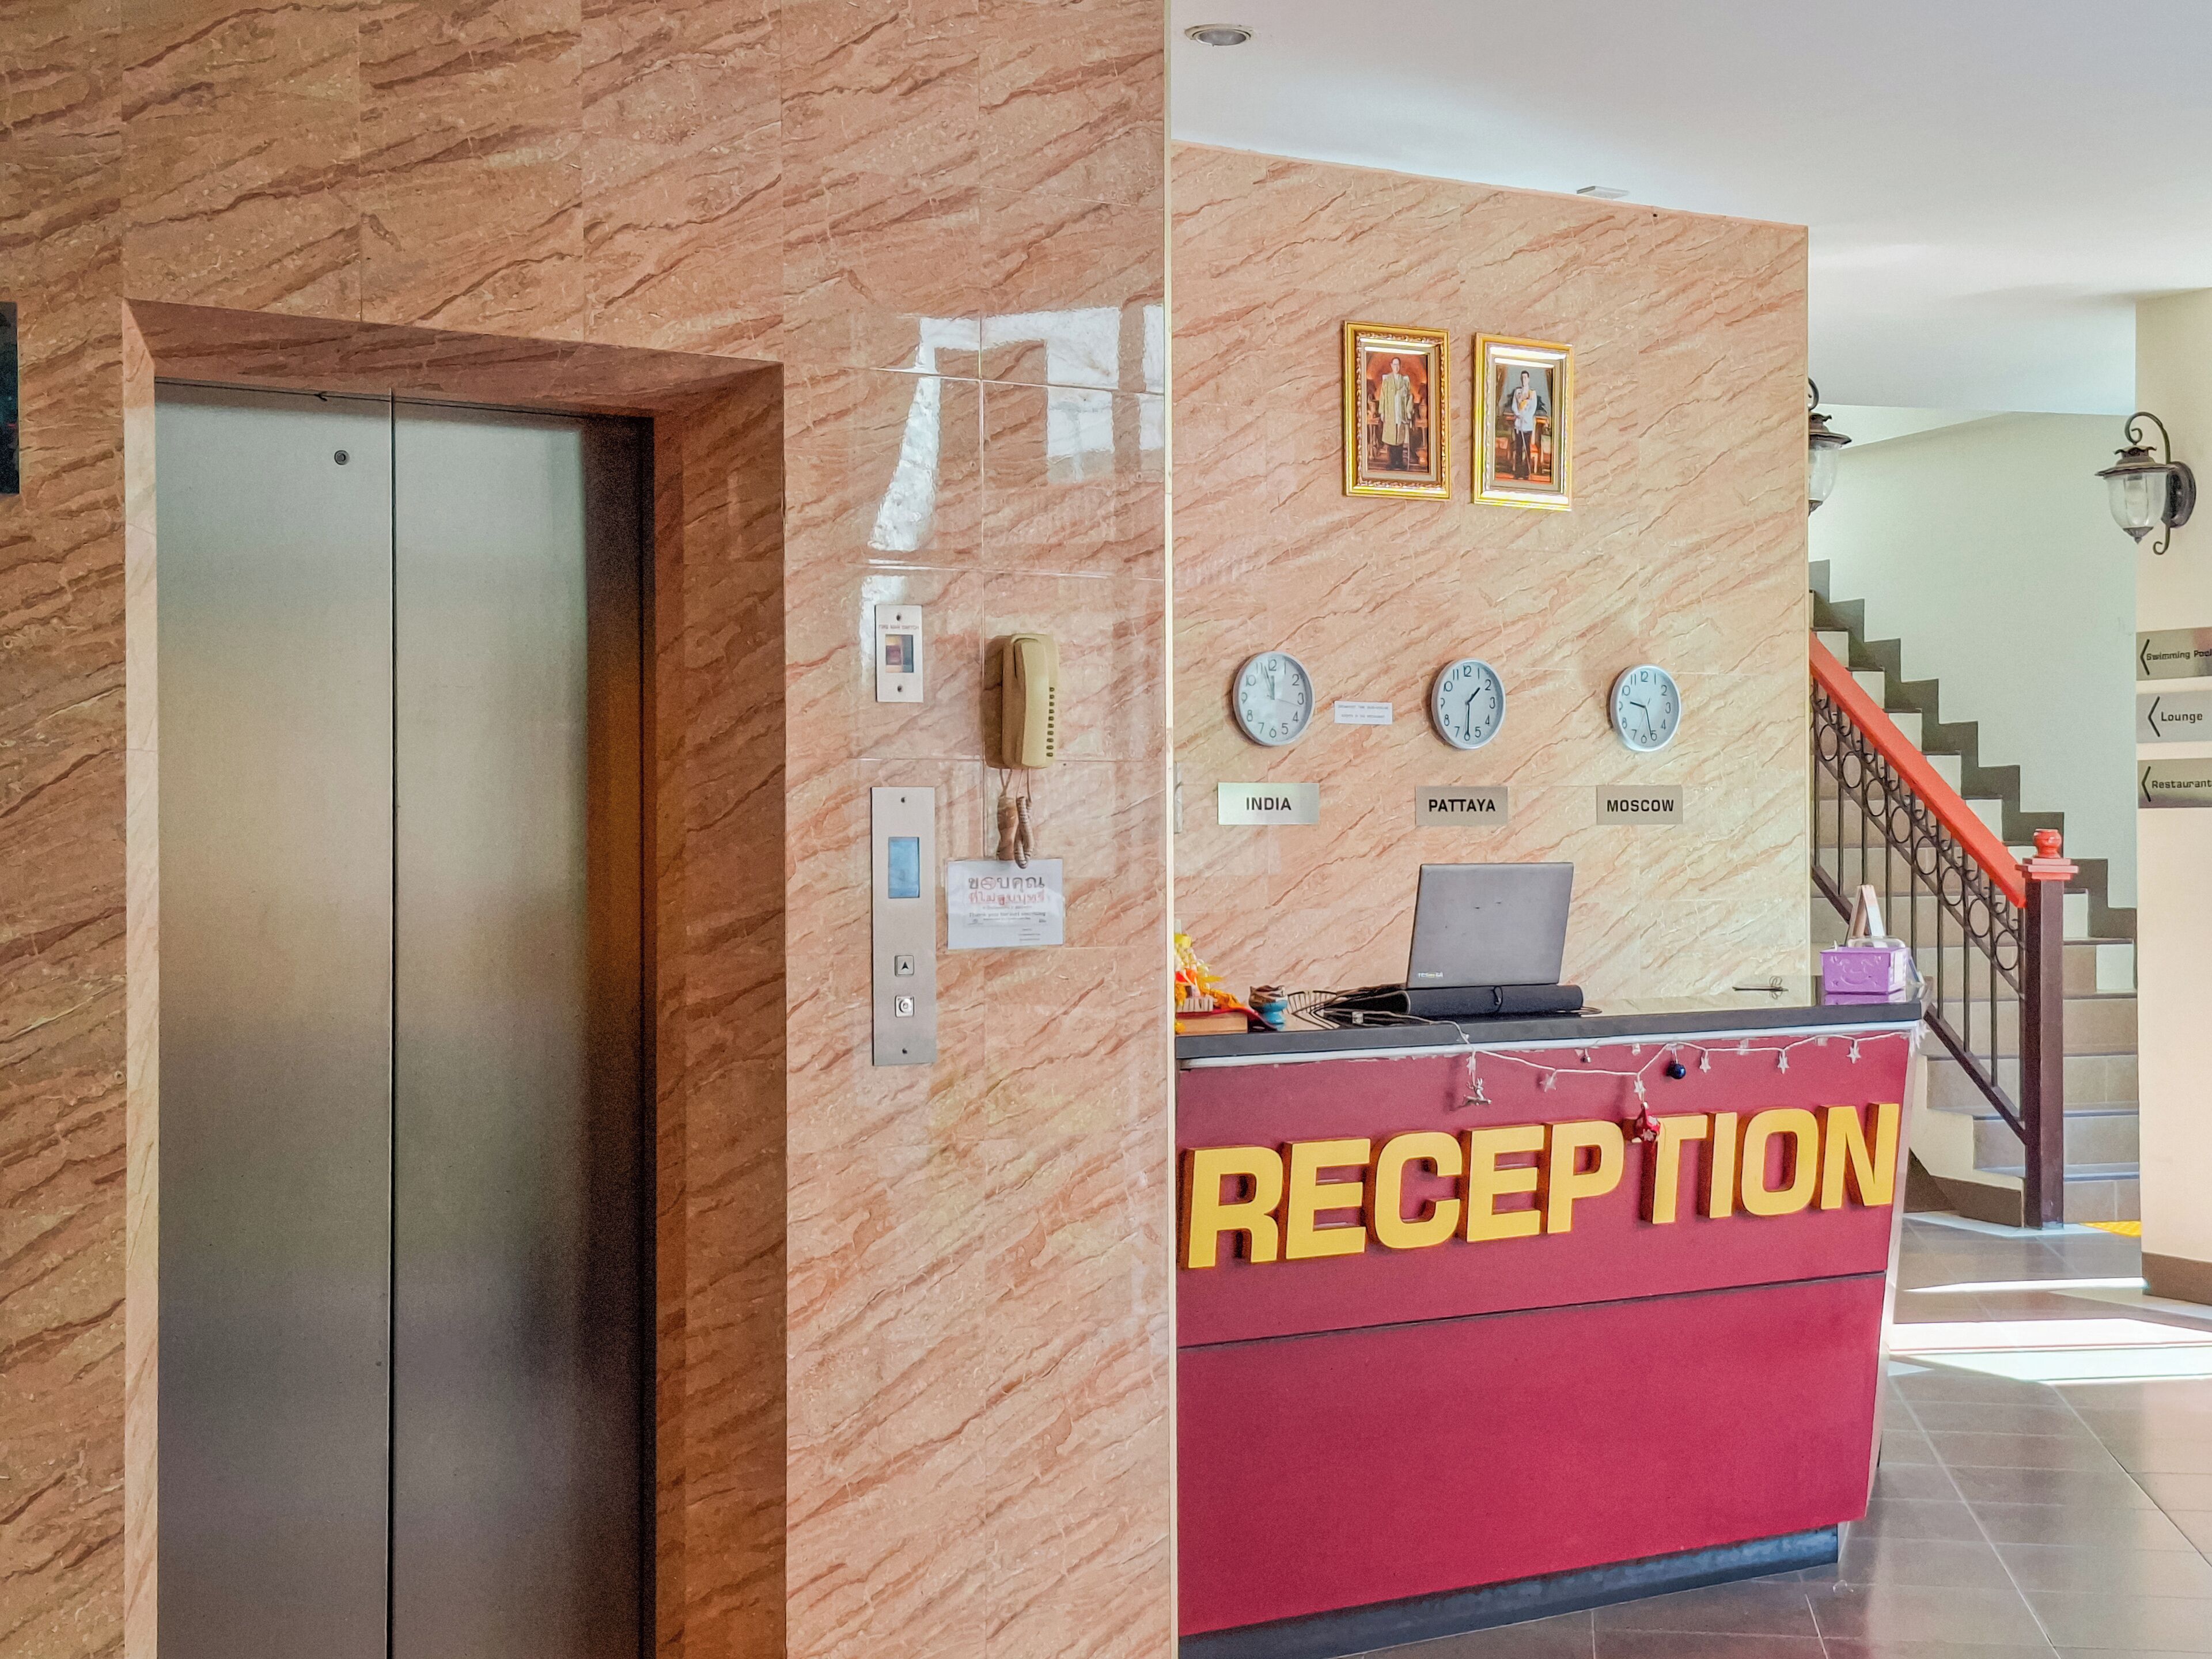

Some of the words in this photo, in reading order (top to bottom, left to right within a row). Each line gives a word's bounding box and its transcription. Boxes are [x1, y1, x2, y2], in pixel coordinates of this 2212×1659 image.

[2146, 650, 2190, 661] Swimming
[2193, 648, 2212, 658] Pool
[1256, 662, 1263, 675] 11
[1268, 658, 1277, 672] 12
[1463, 665, 1472, 677] 12
[1291, 673, 1300, 686] 2
[1452, 668, 1459, 680] 11
[1630, 673, 1637, 685] 11
[1640, 671, 1649, 683] 12
[1245, 675, 1256, 687] 10
[1443, 680, 1453, 692] 10
[1484, 679, 1491, 691] 2
[1622, 685, 1631, 696] 10
[1661, 684, 1668, 696] 2
[1297, 692, 1304, 705] 3
[1488, 696, 1495, 709] 3
[1665, 702, 1671, 714] 3
[1246, 709, 1253, 722] 8
[1293, 711, 1299, 723] 4
[1444, 714, 1450, 726] 8
[1484, 714, 1490, 725] 4
[2161, 711, 2203, 724] Lounge
[1258, 722, 1264, 734] 7
[1281, 722, 1289, 735] 5
[1622, 717, 1627, 729] 8
[1660, 718, 1666, 730] 4
[1269, 726, 1277, 738] 6
[1454, 726, 1460, 738] 7
[1474, 726, 1482, 738] 5
[1631, 729, 1637, 741] 7
[1641, 733, 1647, 744] 6
[2152, 779, 2212, 789] Restaurant
[1246, 797, 1291, 810] INDIA
[1429, 799, 1495, 812] PATTAYA
[1607, 800, 1674, 812] MOSCOW
[1184, 1103, 1901, 1269] RECEPTION
